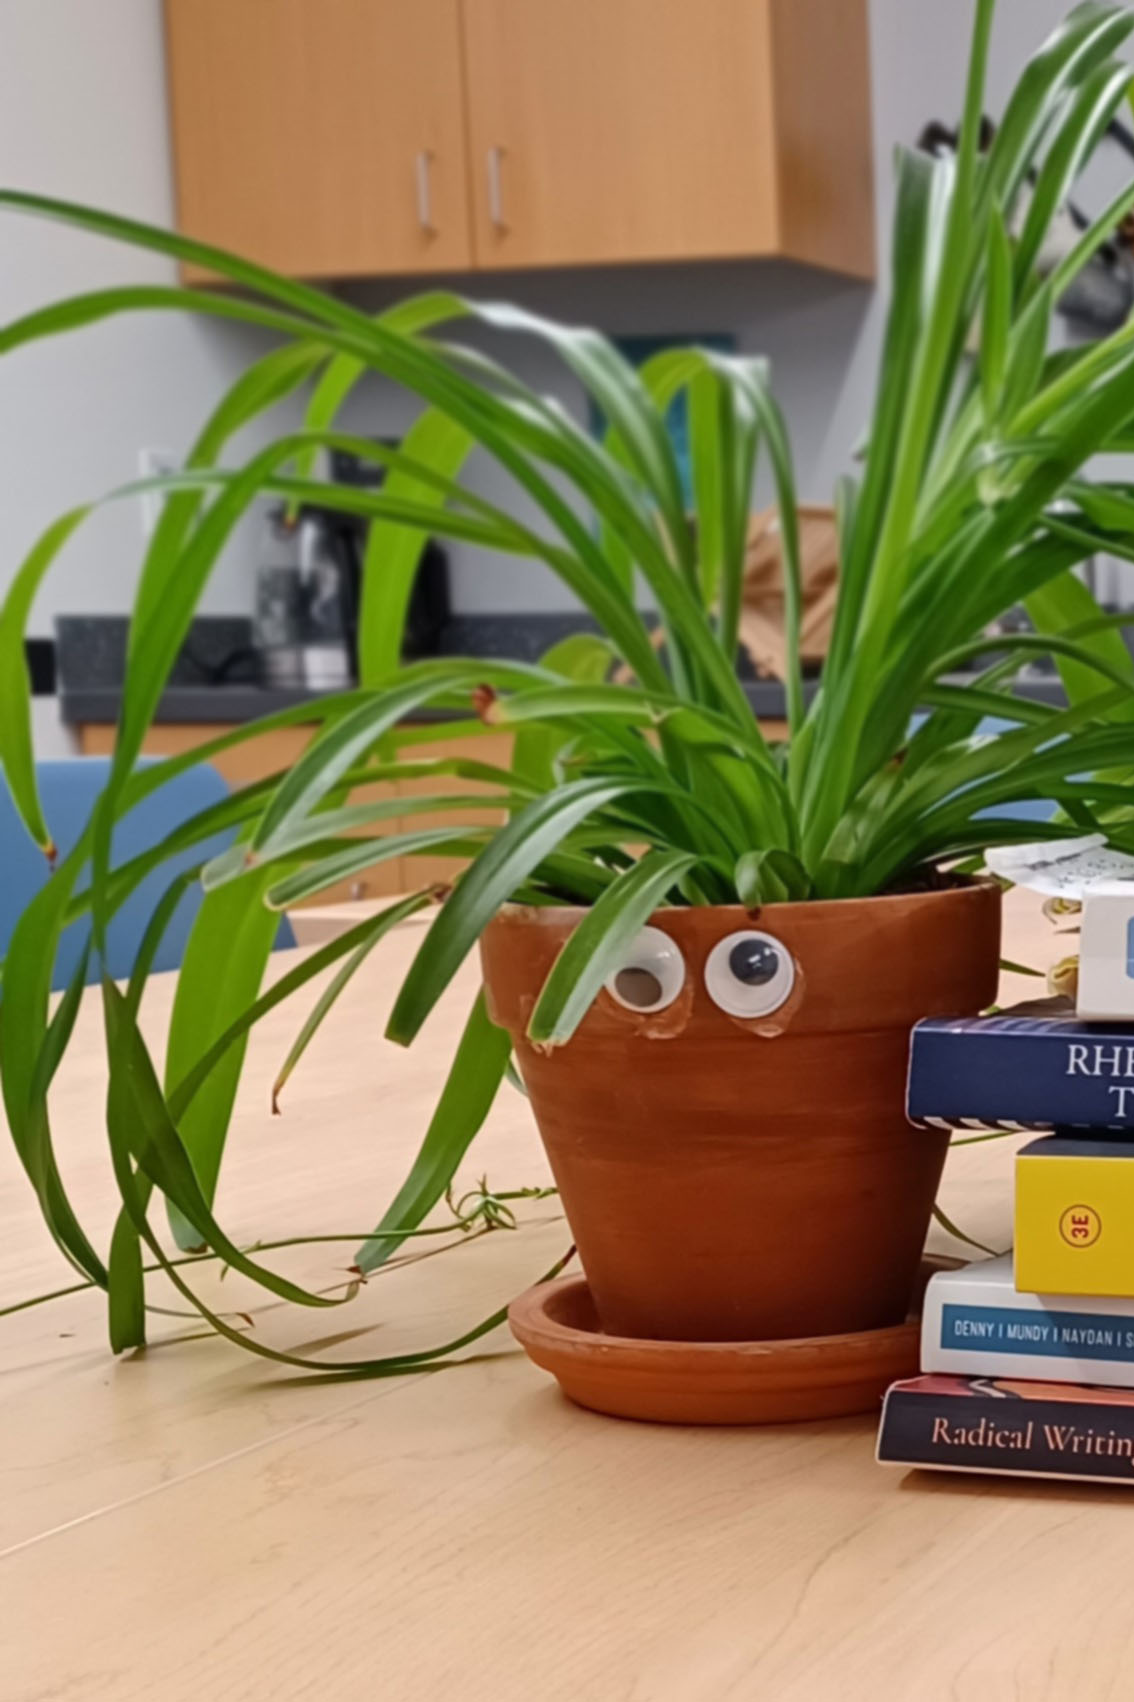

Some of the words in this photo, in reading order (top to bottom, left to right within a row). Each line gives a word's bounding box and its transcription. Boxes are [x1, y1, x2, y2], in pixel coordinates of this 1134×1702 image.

[954, 1320, 994, 1337] DENNY
[1007, 1324, 1049, 1341] MUNDY
[1062, 1329, 1113, 1347] NAYDAN
[931, 1417, 1034, 1450] Radical
